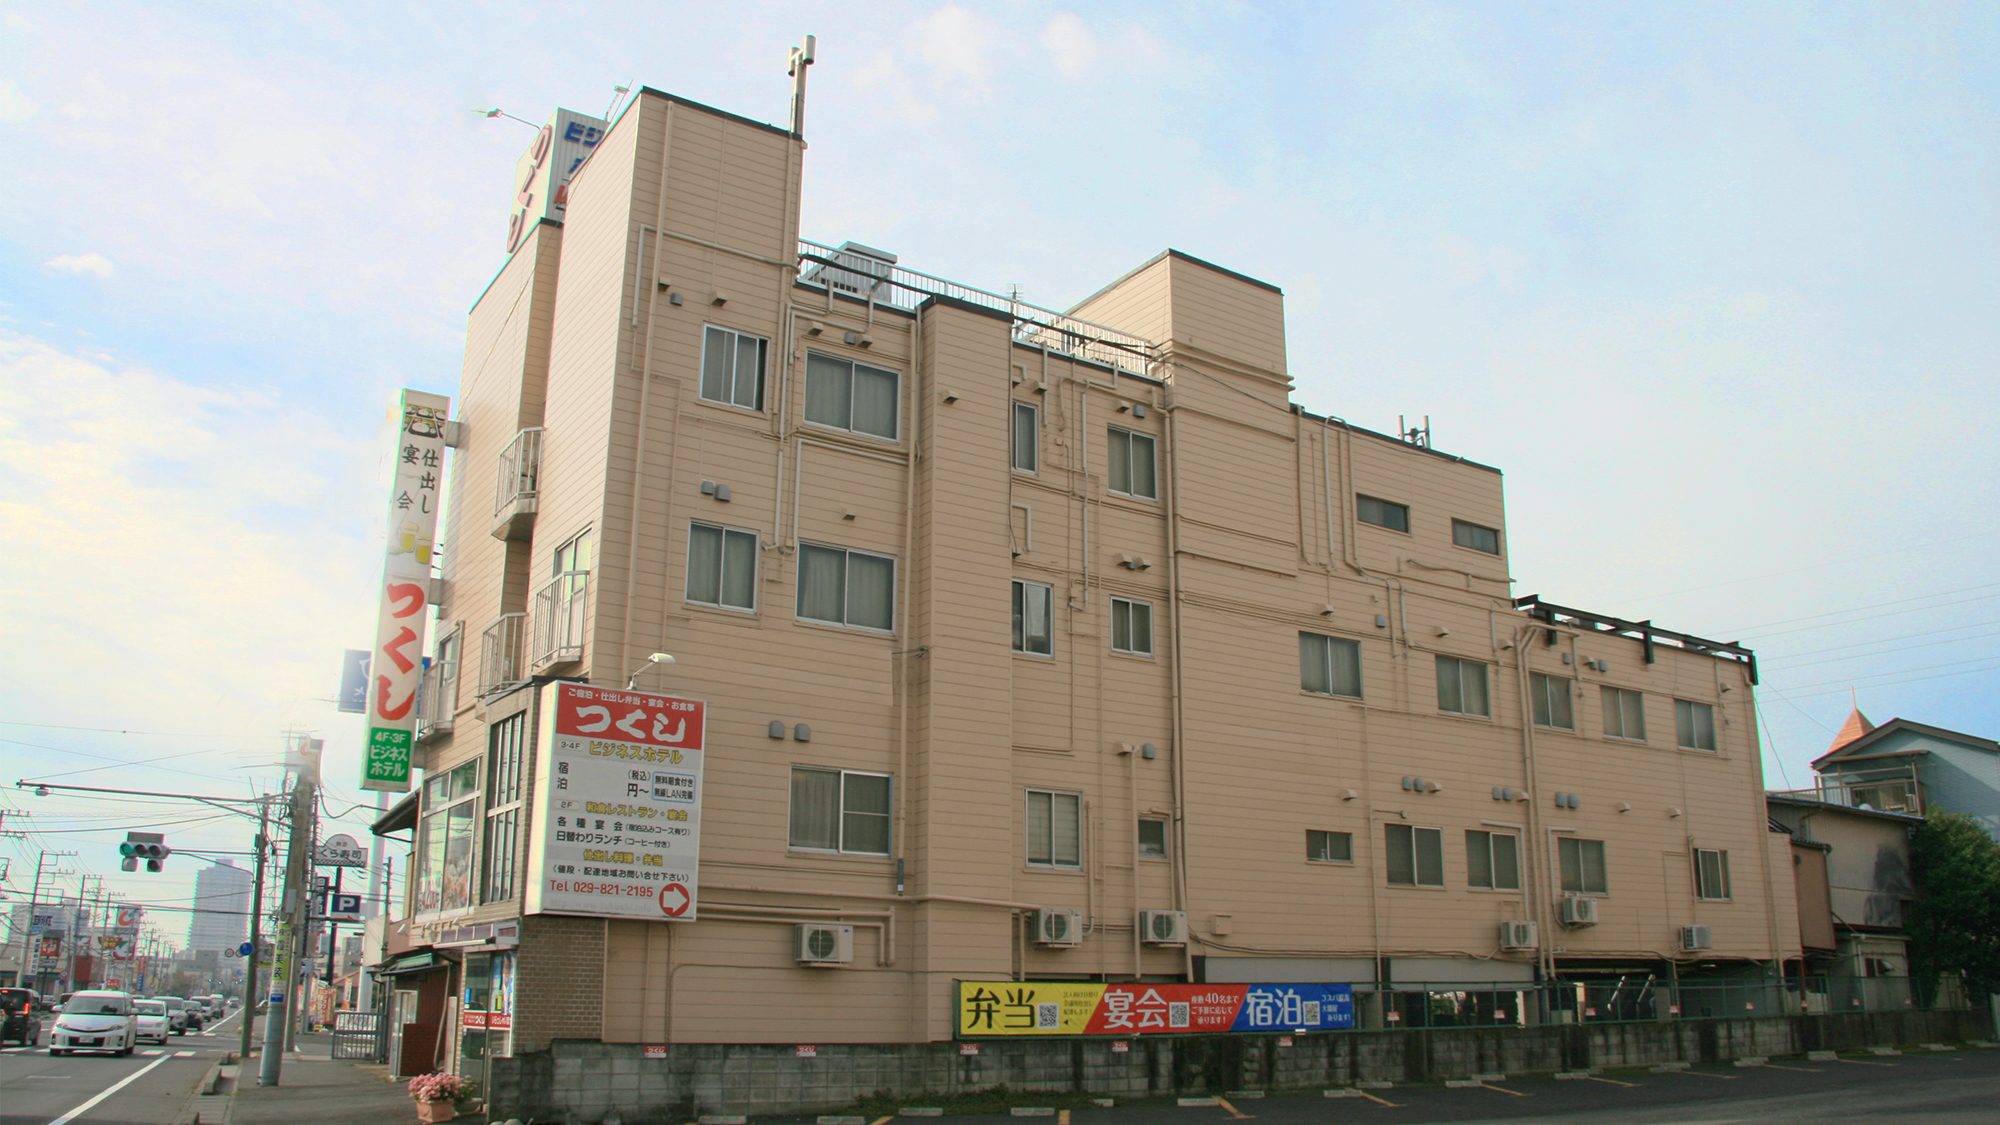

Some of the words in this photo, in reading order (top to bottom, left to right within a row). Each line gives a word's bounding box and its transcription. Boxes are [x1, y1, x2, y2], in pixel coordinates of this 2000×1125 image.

[420, 448, 439, 514] 仕出し
[376, 583, 425, 721] つくし
[575, 705, 686, 743] つくし
[370, 745, 408, 761] ビジネス
[589, 740, 684, 764] ビジネスホテル
[370, 761, 405, 777] ホテル
[557, 830, 622, 846] 日替わりランチ
[339, 897, 356, 911] P
[550, 880, 569, 892] Tel
[573, 881, 653, 898] 029-821-2195
[966, 987, 1035, 1029] 弁当
[1103, 988, 1167, 1029] 宴会
[1246, 988, 1302, 1026] 宿泊
